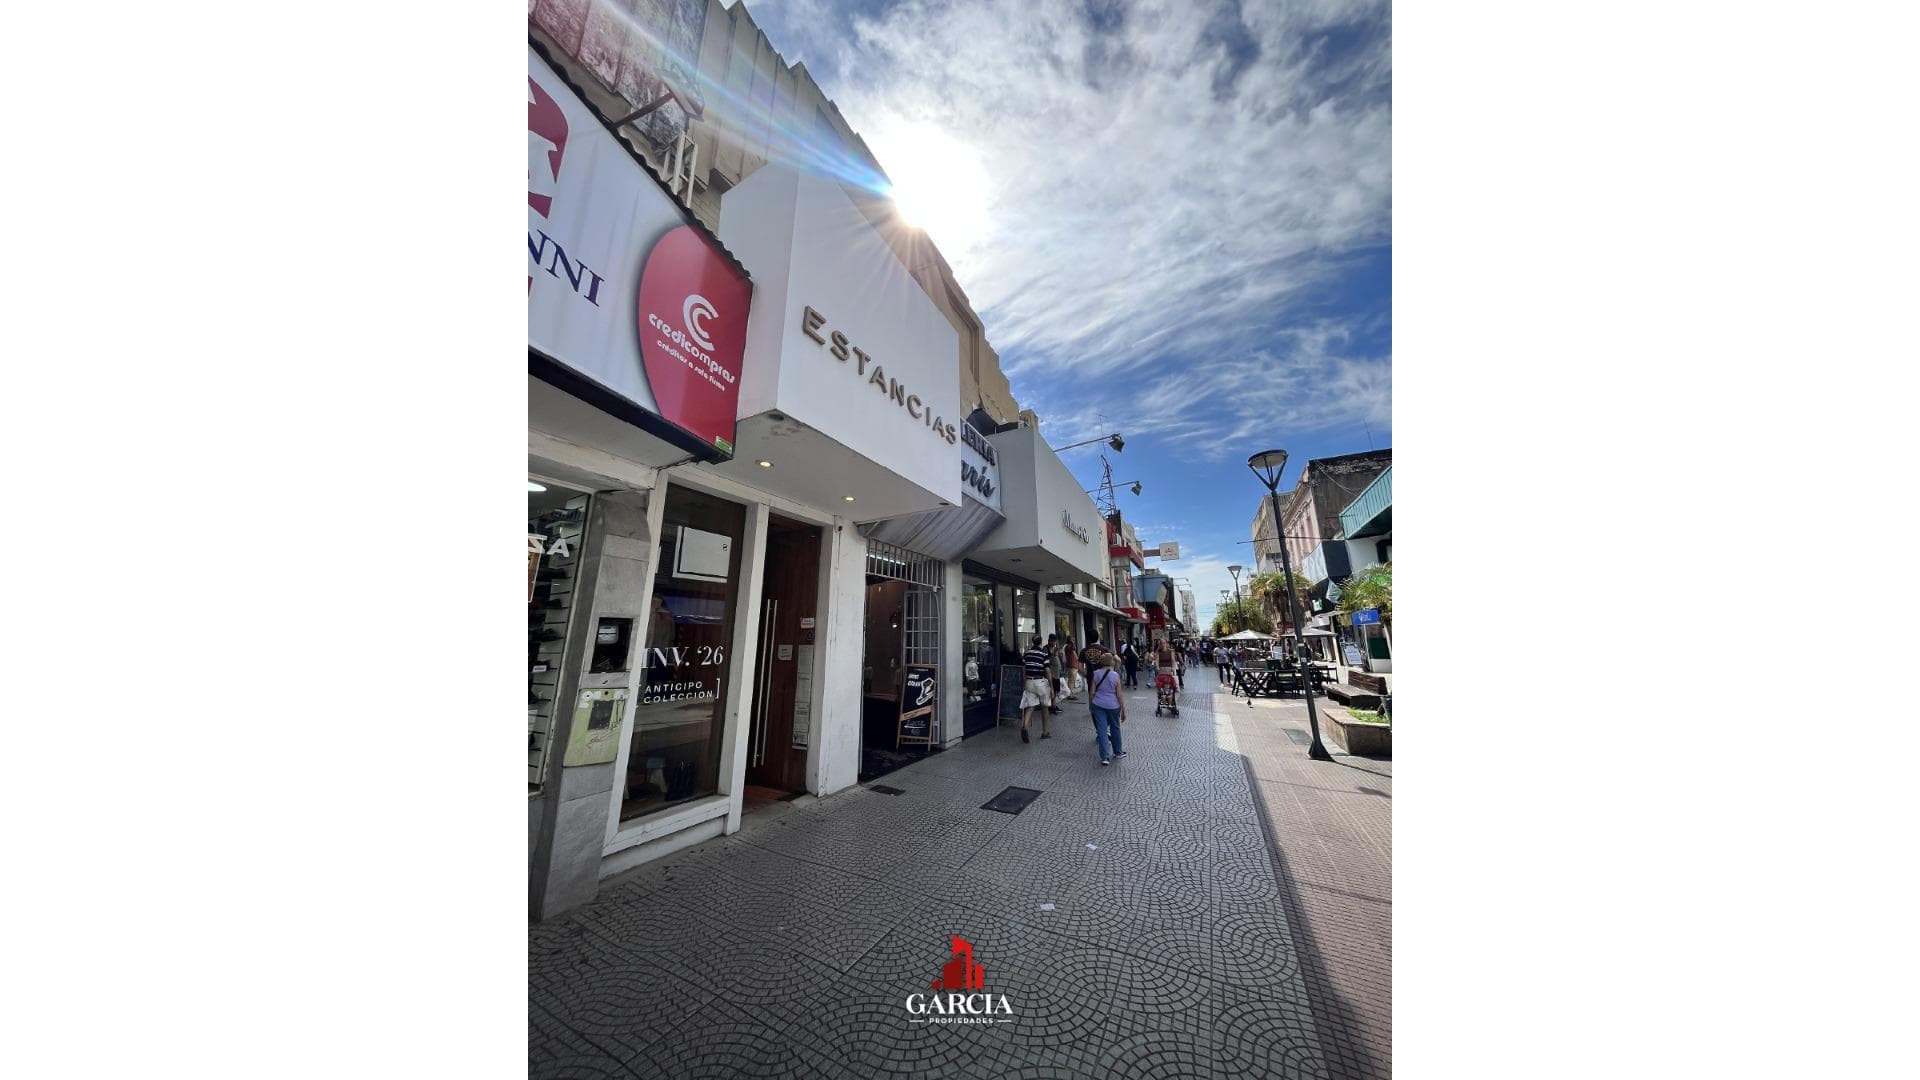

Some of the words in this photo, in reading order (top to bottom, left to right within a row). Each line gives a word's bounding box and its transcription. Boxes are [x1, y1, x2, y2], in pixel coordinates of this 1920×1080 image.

[648, 313, 735, 384] credicompras
[802, 306, 957, 445] ESTANCIAS
[640, 646, 690, 669] INV.
[643, 690, 713, 704] COLECCION
[644, 681, 703, 694] ANTICIPO
